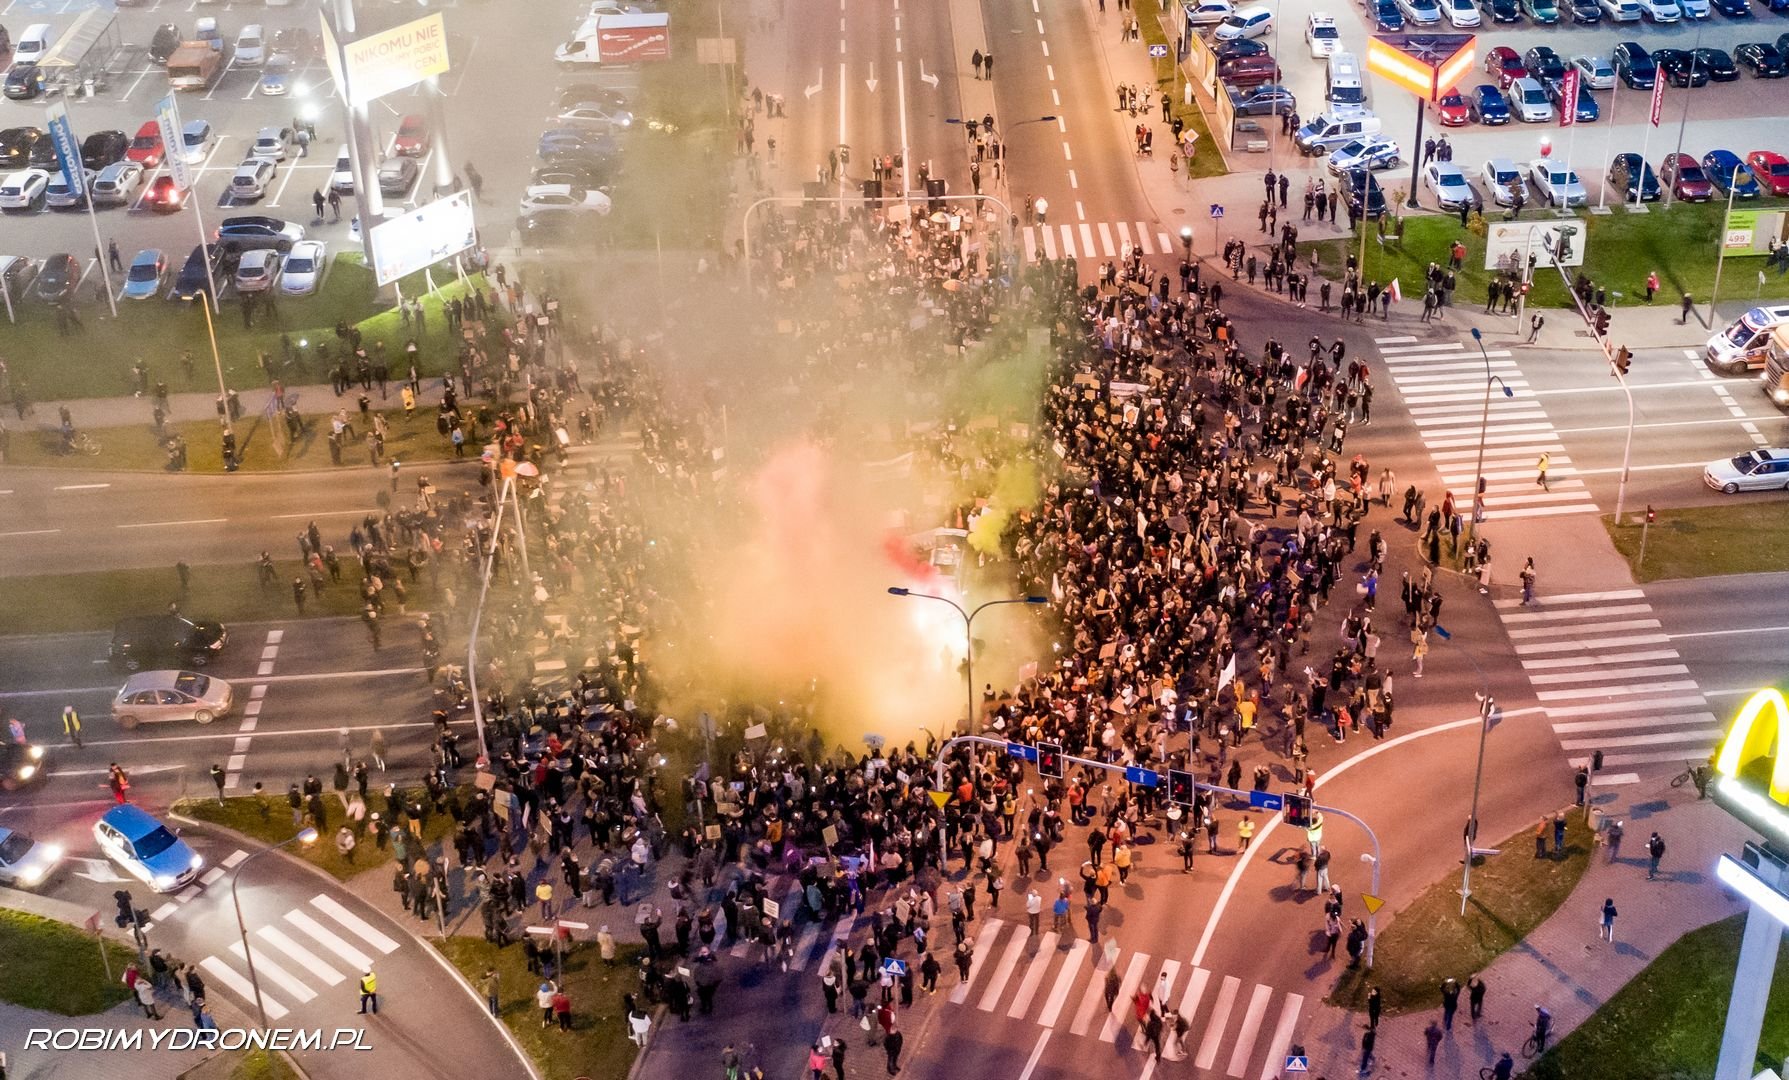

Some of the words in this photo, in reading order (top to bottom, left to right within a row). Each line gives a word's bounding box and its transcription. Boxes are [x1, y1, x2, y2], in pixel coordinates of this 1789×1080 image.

[354, 33, 412, 64] NIKOMU
[416, 24, 438, 42] NIE
[1653, 72, 1665, 123] NEONET
